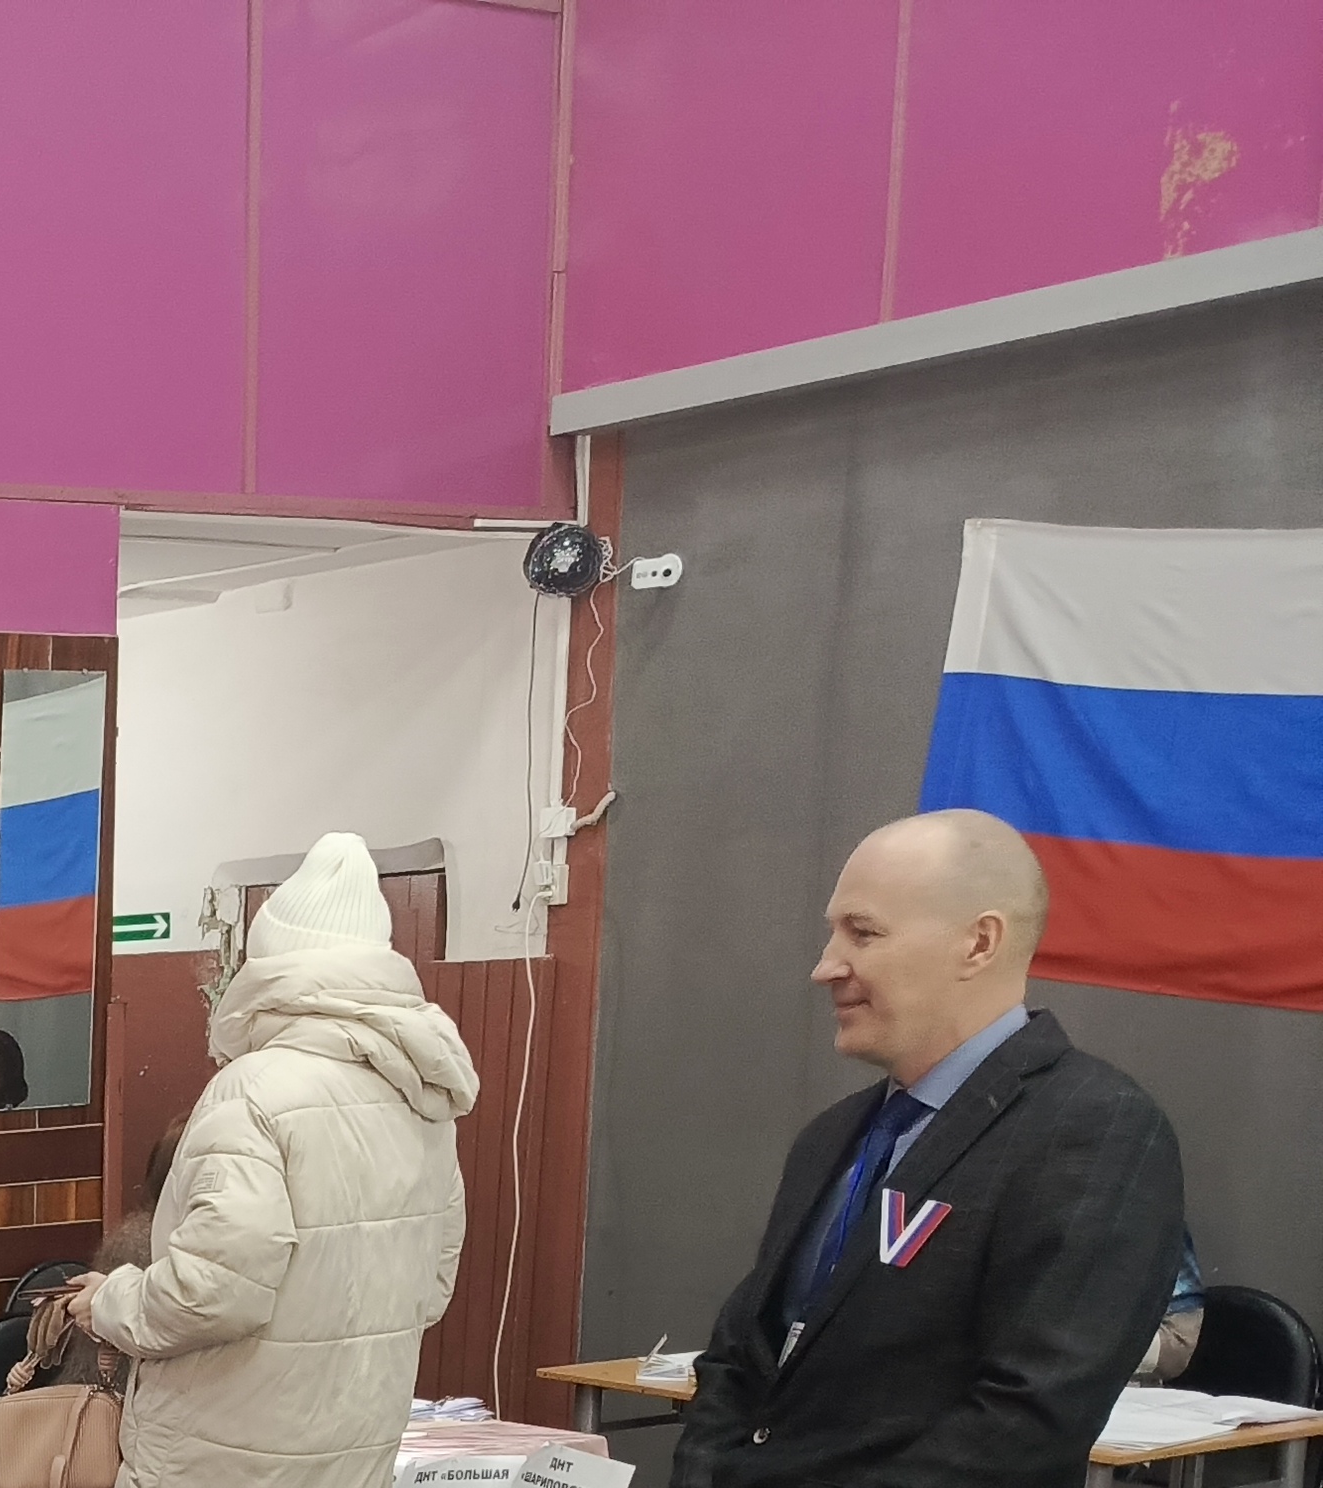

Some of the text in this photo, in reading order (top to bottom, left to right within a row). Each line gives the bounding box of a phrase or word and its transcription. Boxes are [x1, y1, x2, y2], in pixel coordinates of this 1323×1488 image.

[549, 1457, 574, 1473] ДНТ
[414, 1469, 510, 1484] ДНТ «БОЛЬШАЯ
